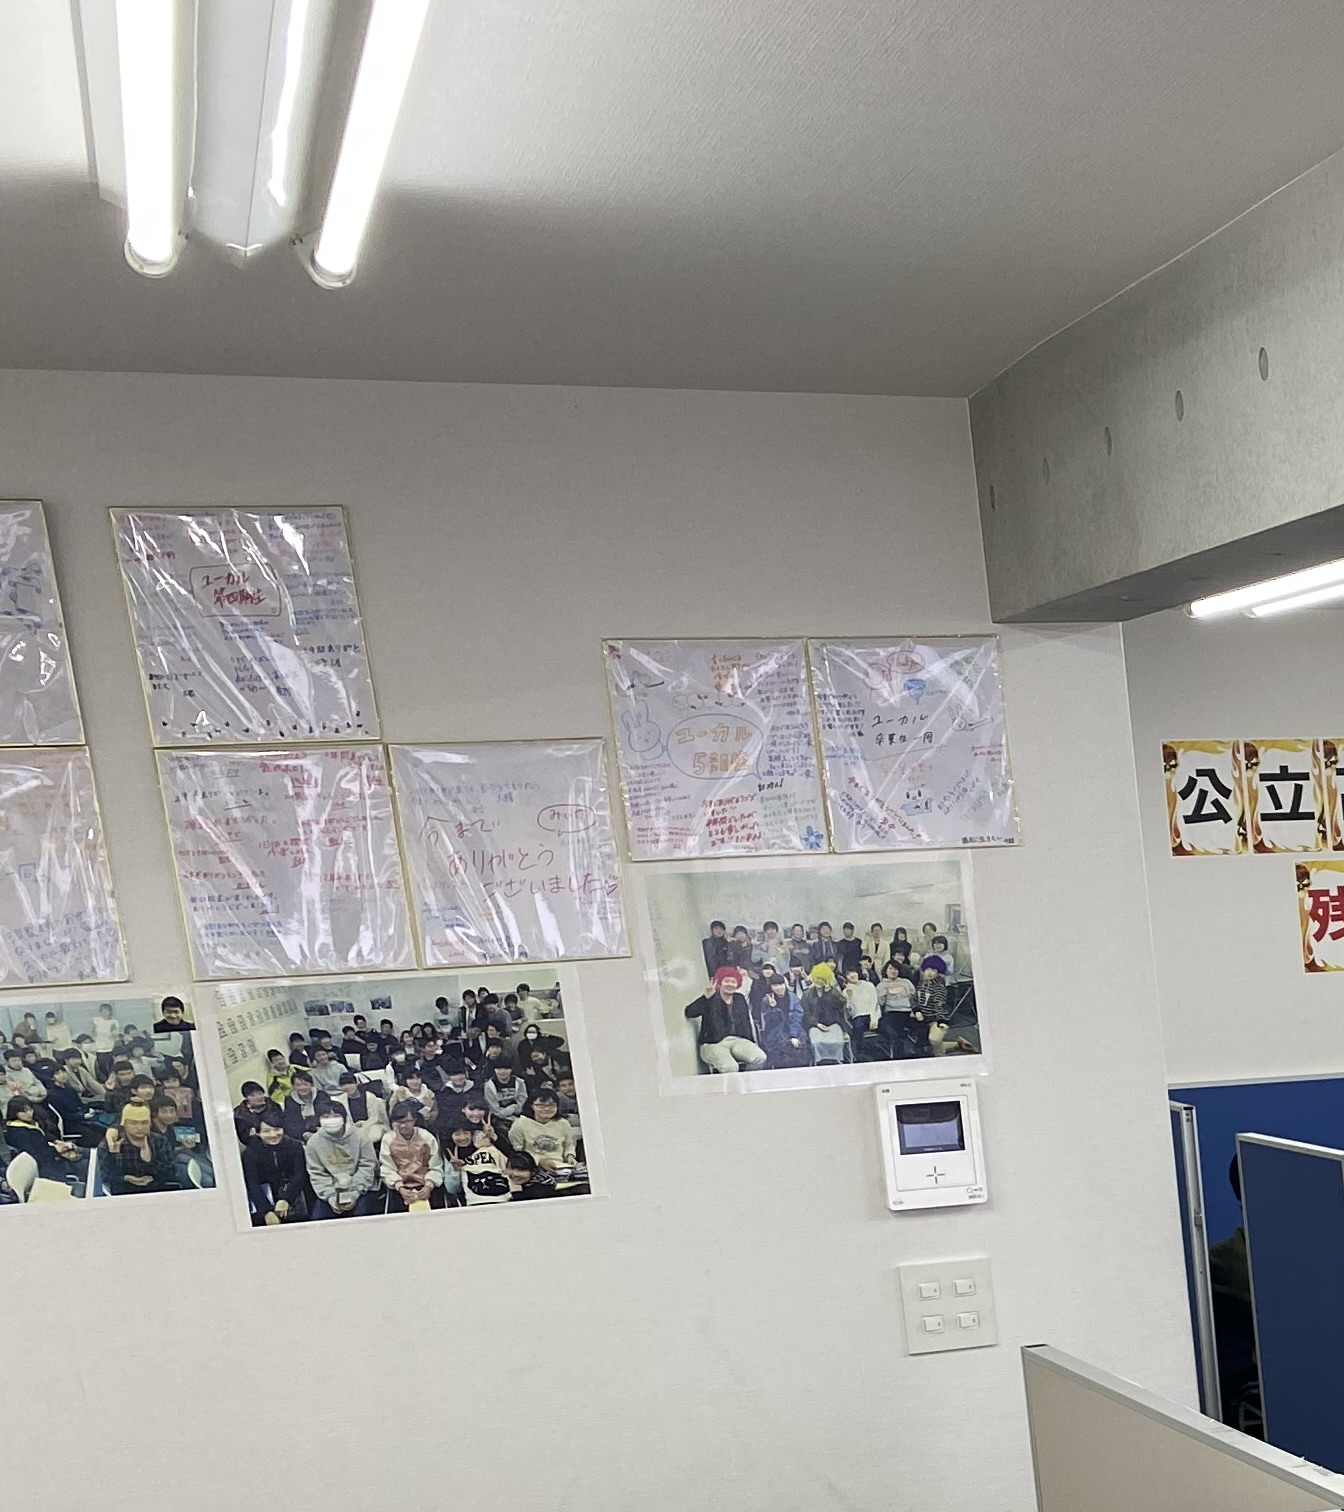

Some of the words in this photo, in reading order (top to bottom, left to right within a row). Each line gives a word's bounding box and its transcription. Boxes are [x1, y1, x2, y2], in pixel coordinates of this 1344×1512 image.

[448, 843, 555, 878] ありがとう
